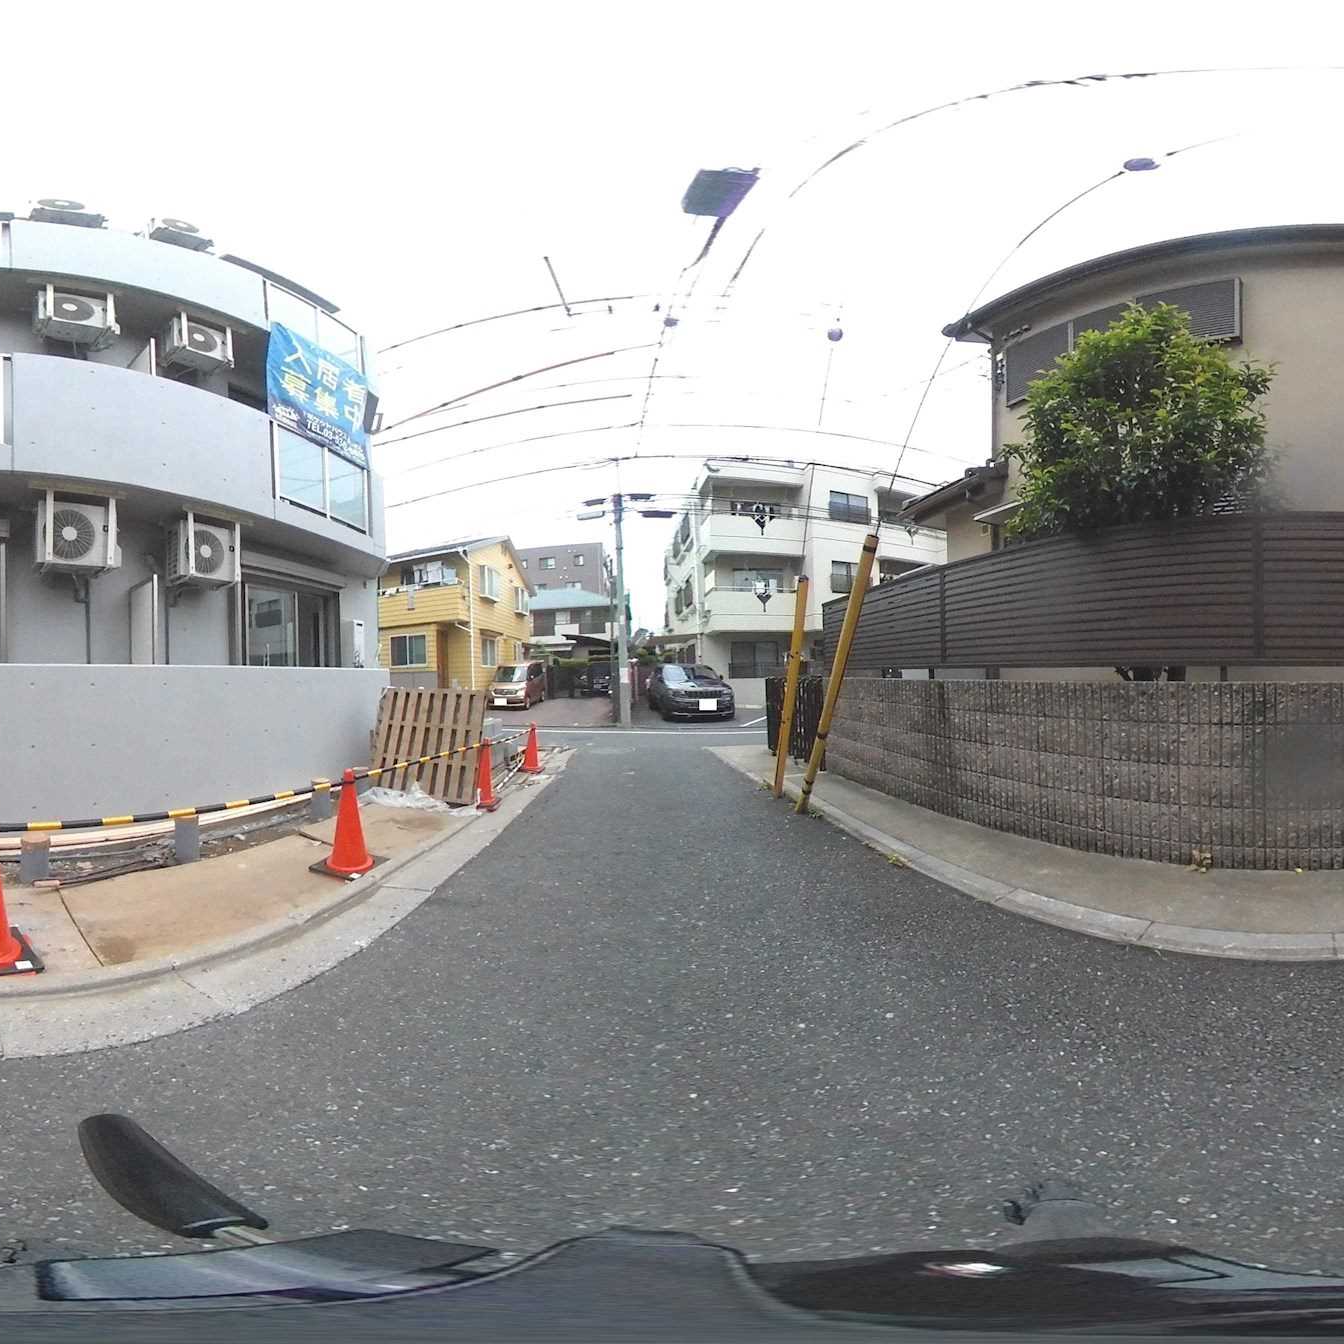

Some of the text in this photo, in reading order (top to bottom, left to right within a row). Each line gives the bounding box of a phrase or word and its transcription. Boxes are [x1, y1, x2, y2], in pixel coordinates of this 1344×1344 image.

[281, 366, 364, 433] 募集中
[284, 329, 367, 404] 入居者
